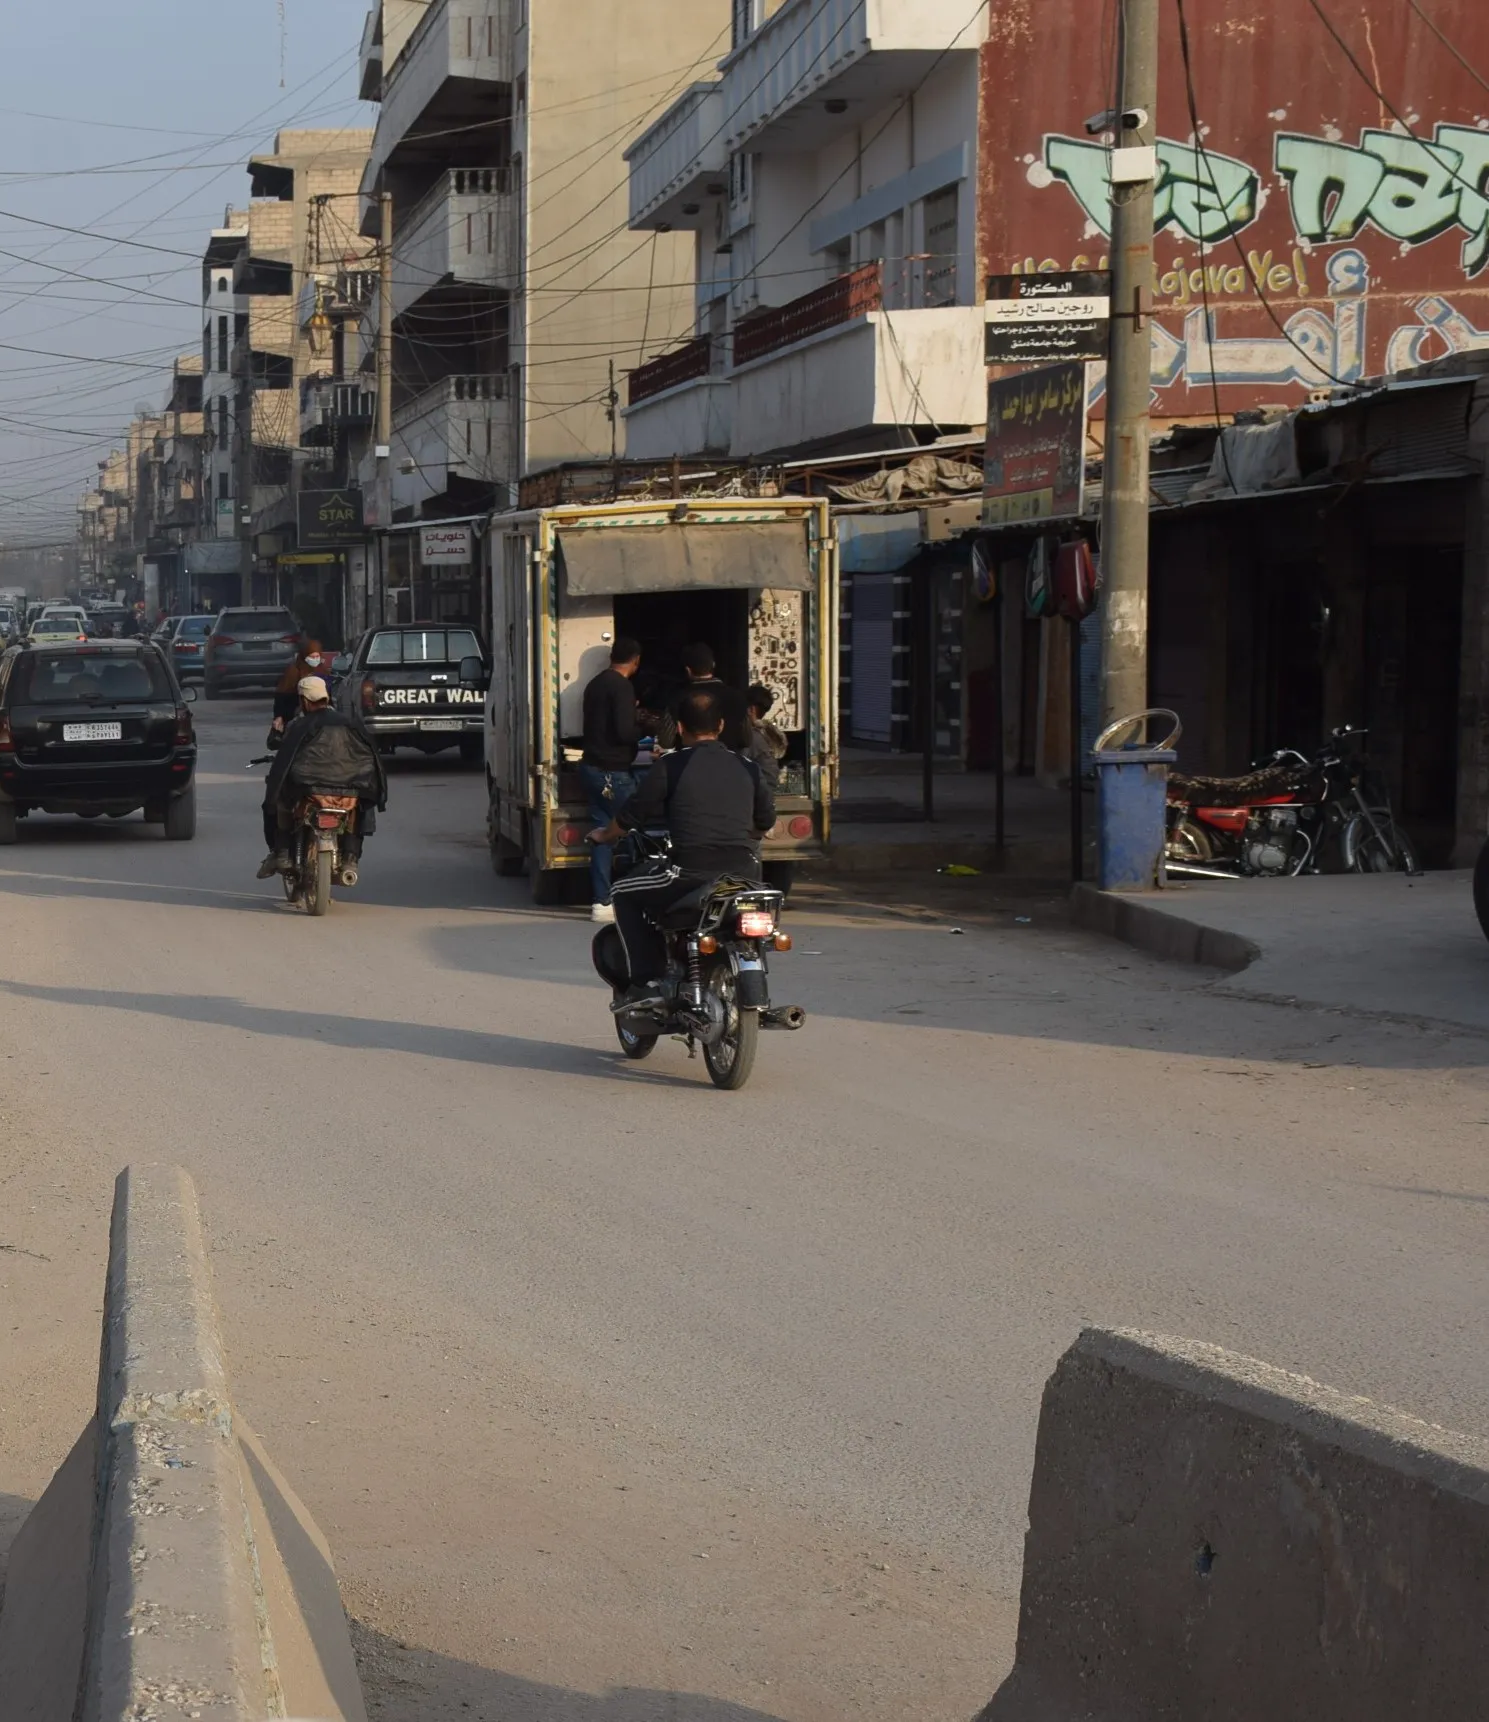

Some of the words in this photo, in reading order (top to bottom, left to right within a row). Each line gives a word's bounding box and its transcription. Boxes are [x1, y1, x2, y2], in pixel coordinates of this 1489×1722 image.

[1152, 257, 1246, 304] ojava
[1019, 282, 1072, 296] الدكتورة
[997, 303, 1024, 317] رشيد
[1026, 303, 1055, 317] صالح
[1057, 302, 1093, 316] روجين
[319, 509, 354, 521] STAR
[426, 532, 465, 543] حلويات
[384, 689, 438, 703] GREAT
